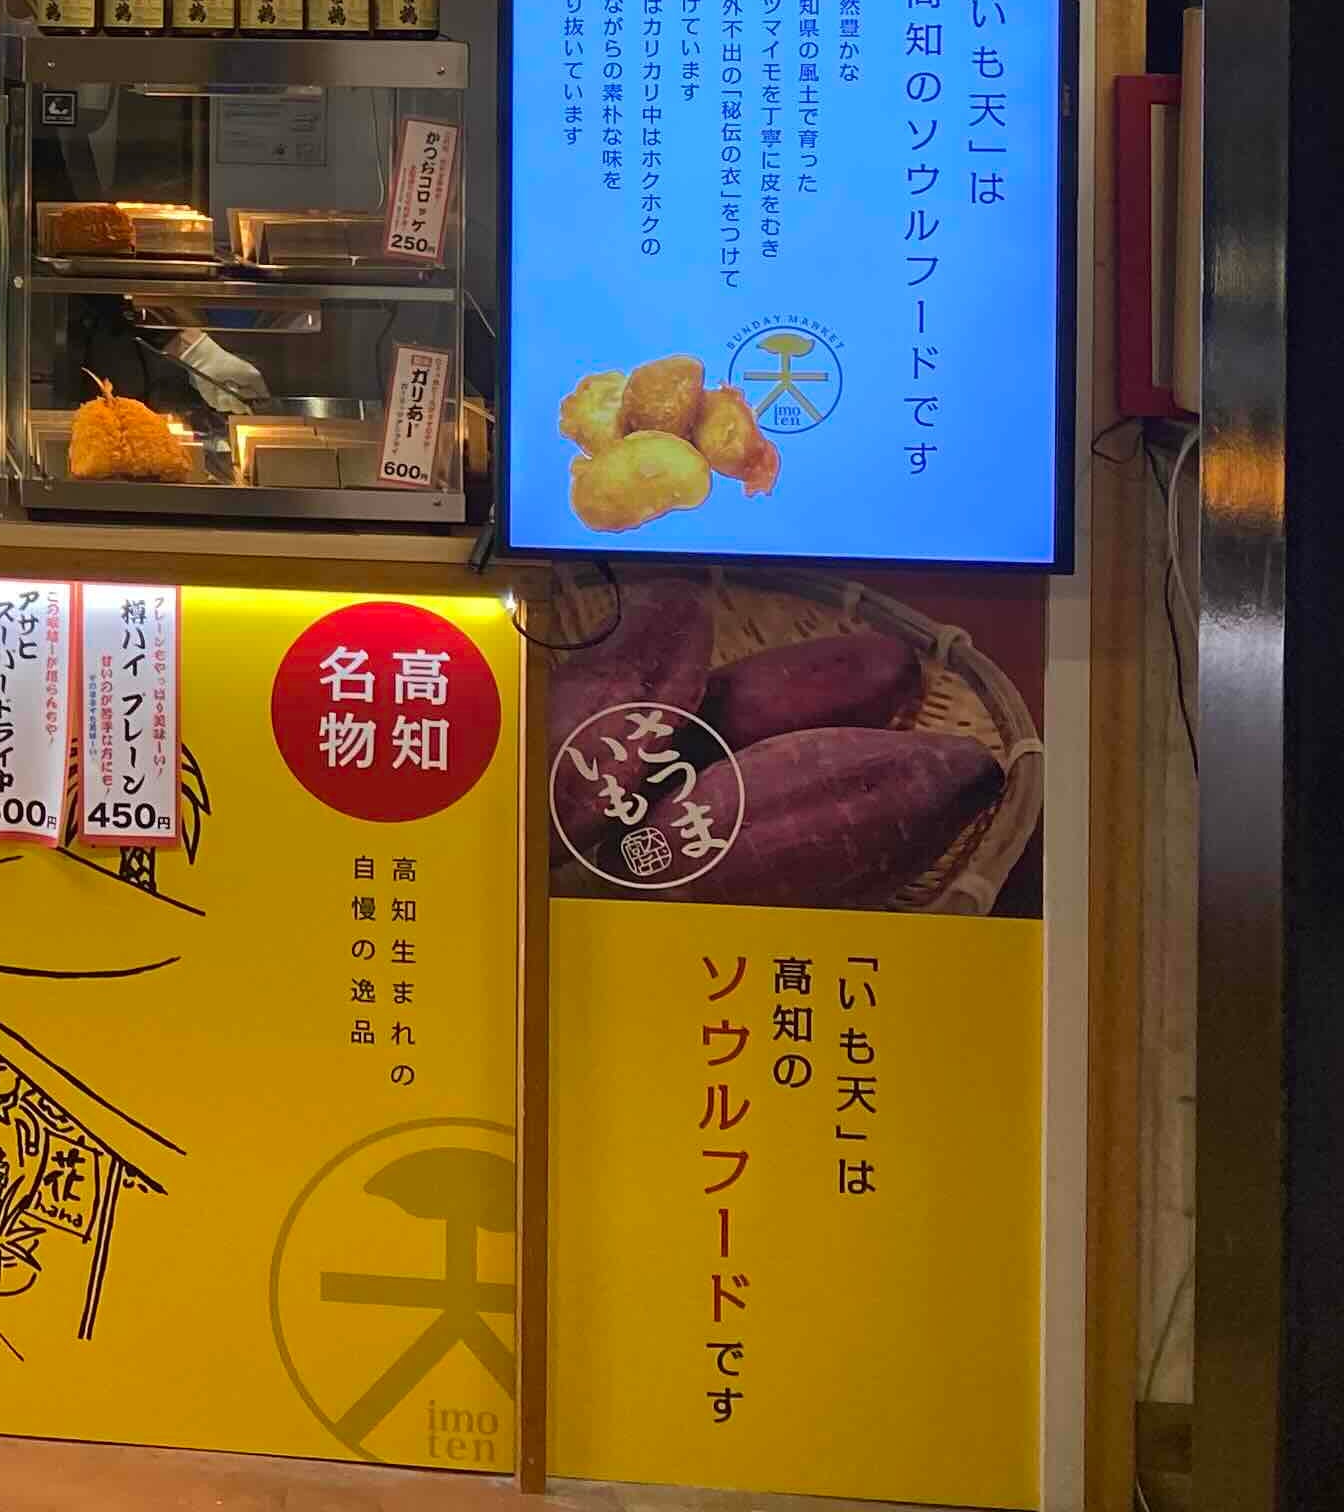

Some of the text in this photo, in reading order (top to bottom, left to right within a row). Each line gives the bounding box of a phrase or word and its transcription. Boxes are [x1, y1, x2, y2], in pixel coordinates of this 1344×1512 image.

[410, 131, 442, 233] かつおコロッケ
[390, 233, 437, 254] 250円
[383, 460, 429, 482] 600円
[18, 590, 40, 660] アサヒ
[87, 802, 172, 830] 450円
[566, 736, 647, 826] いも
[624, 709, 728, 859] さつま
[350, 855, 376, 1046] 自慢の逸品
[390, 856, 417, 1088] 高知生まれの
[773, 957, 813, 1090] 高知の
[836, 954, 879, 1196] 「いも天」は
[700, 954, 752, 1424] ソウルフードです
[428, 1399, 499, 1435] imo
[428, 1433, 497, 1463] ten
